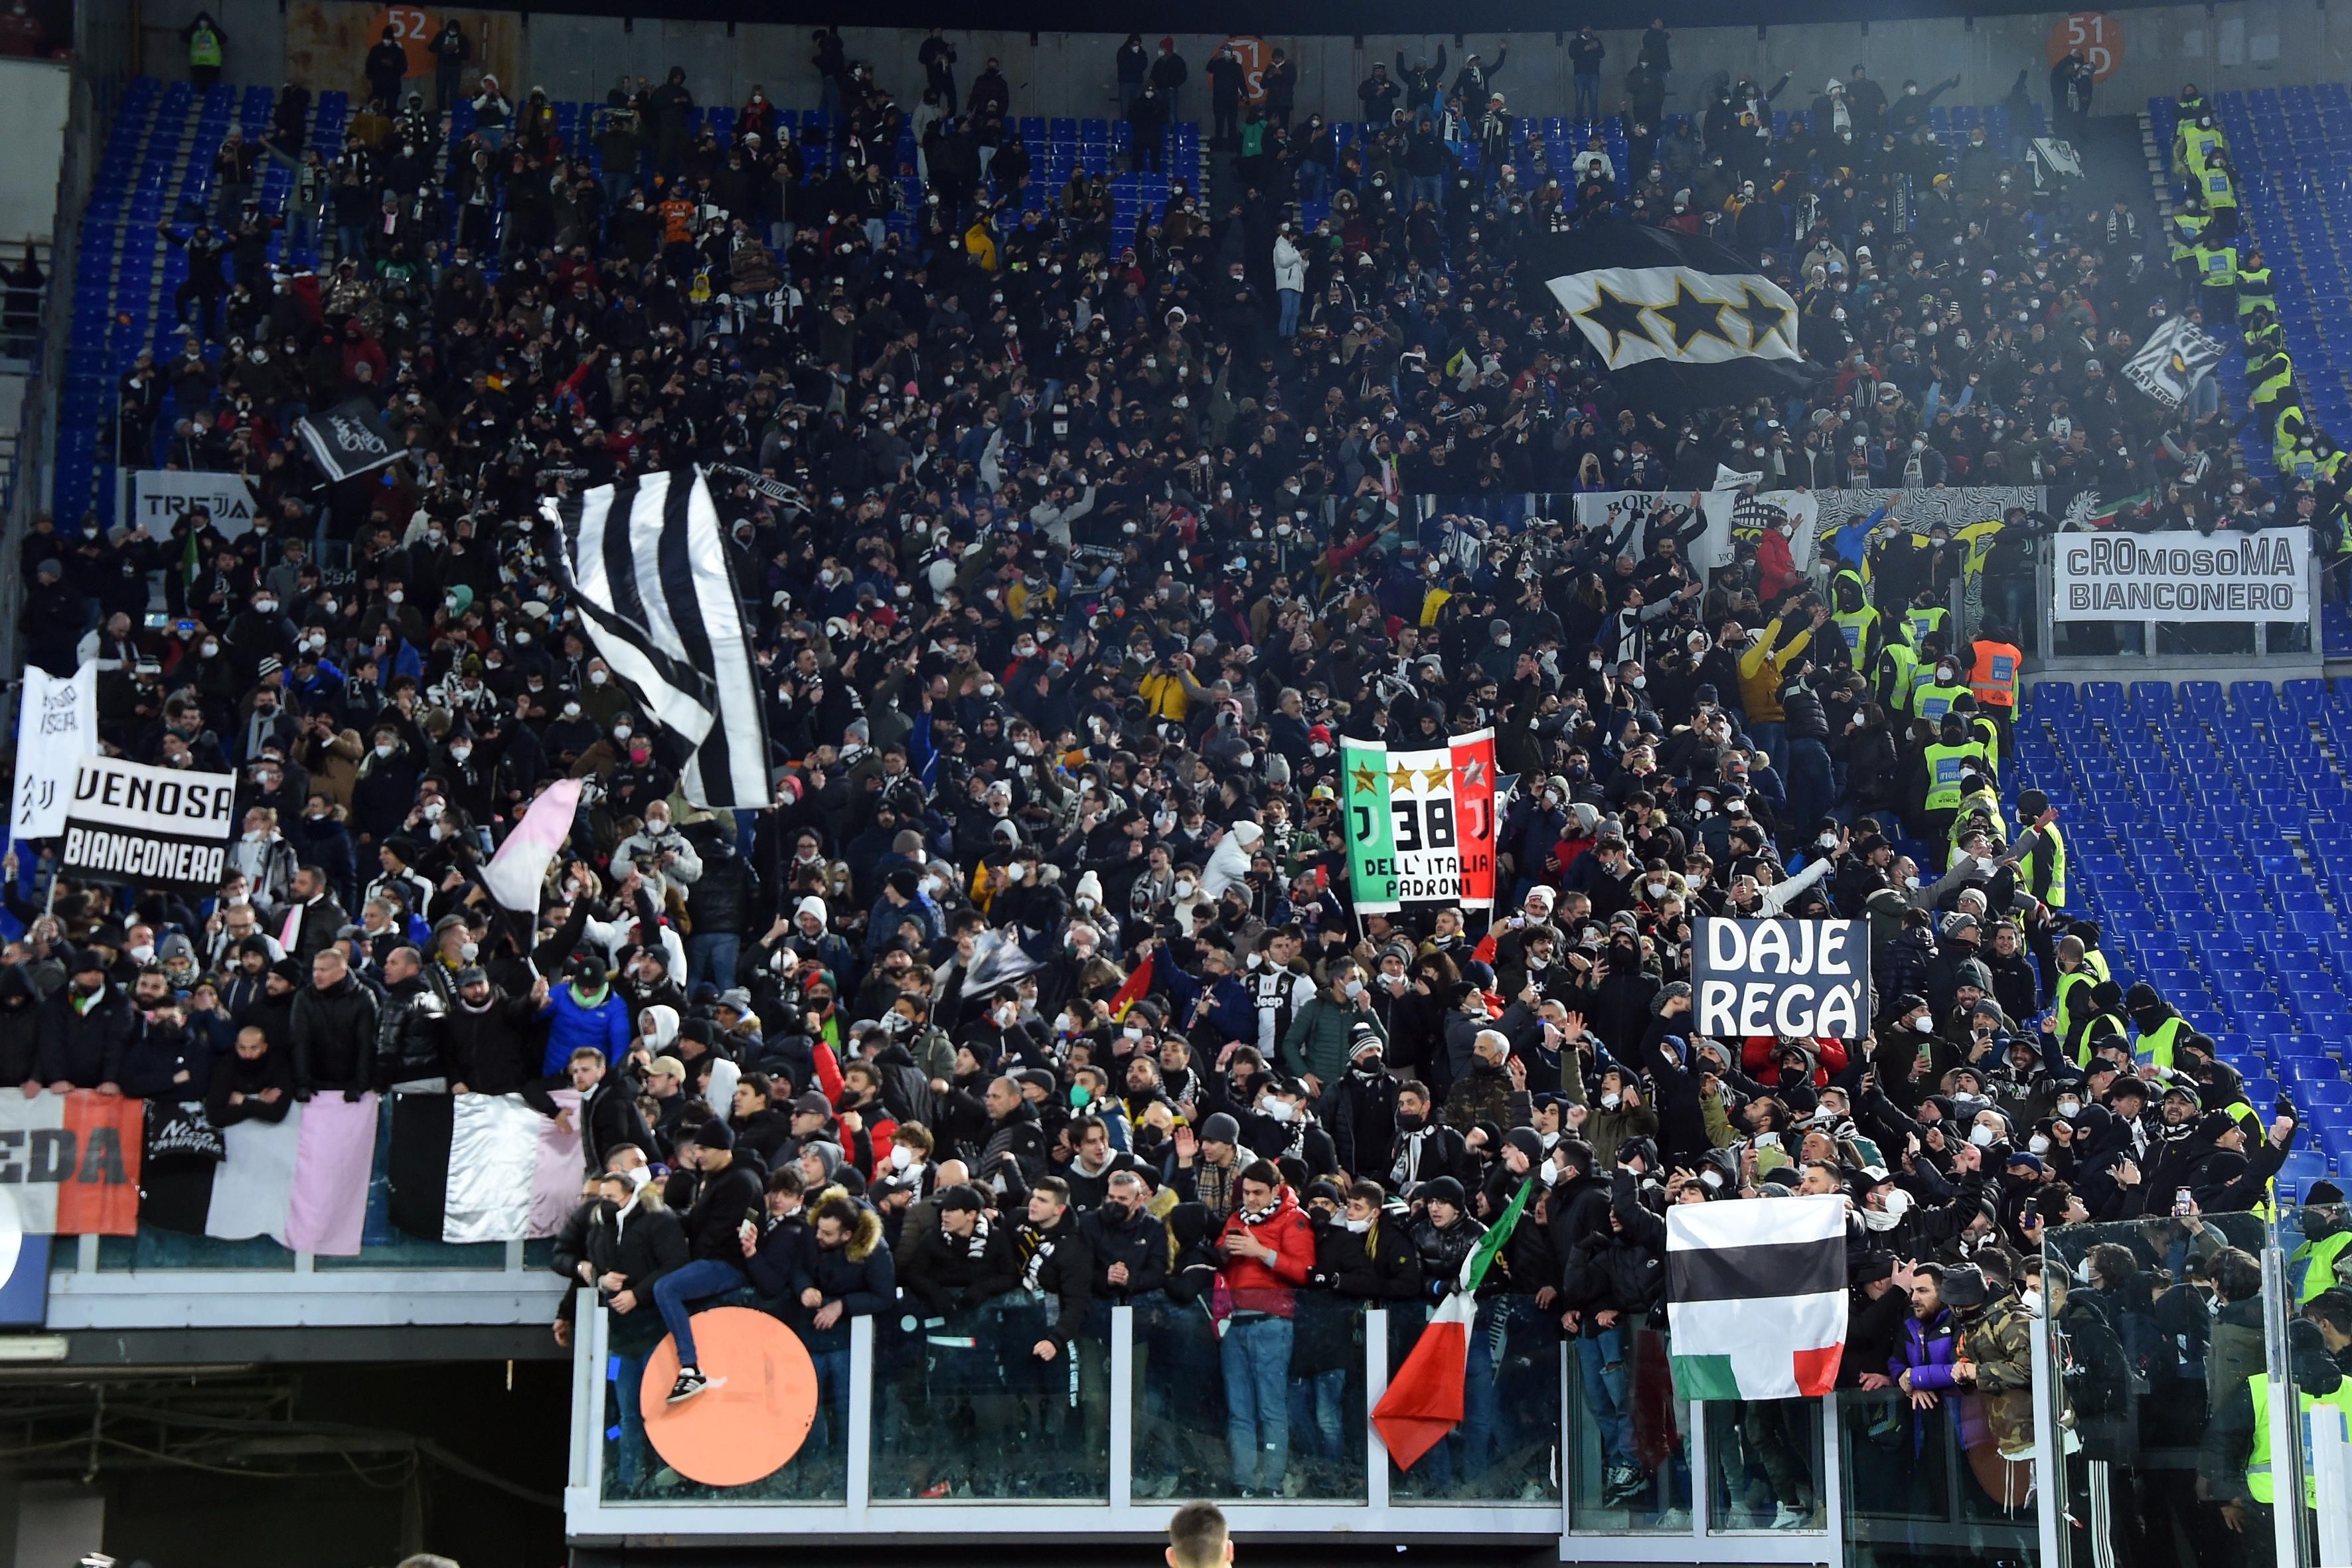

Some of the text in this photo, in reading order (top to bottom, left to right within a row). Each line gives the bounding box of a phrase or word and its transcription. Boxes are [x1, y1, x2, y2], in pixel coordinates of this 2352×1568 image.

[389, 11, 426, 39] 52
[2069, 17, 2102, 44] 51
[2069, 583, 2294, 611] BIANCONERO
[74, 766, 232, 821] VENOSA
[1391, 798, 1455, 852] 38
[64, 827, 226, 884] BIANCONERA
[1386, 878, 1470, 898] PADRONI
[1708, 917, 1851, 975] DAJE
[1253, 996, 1284, 1009] Jeep
